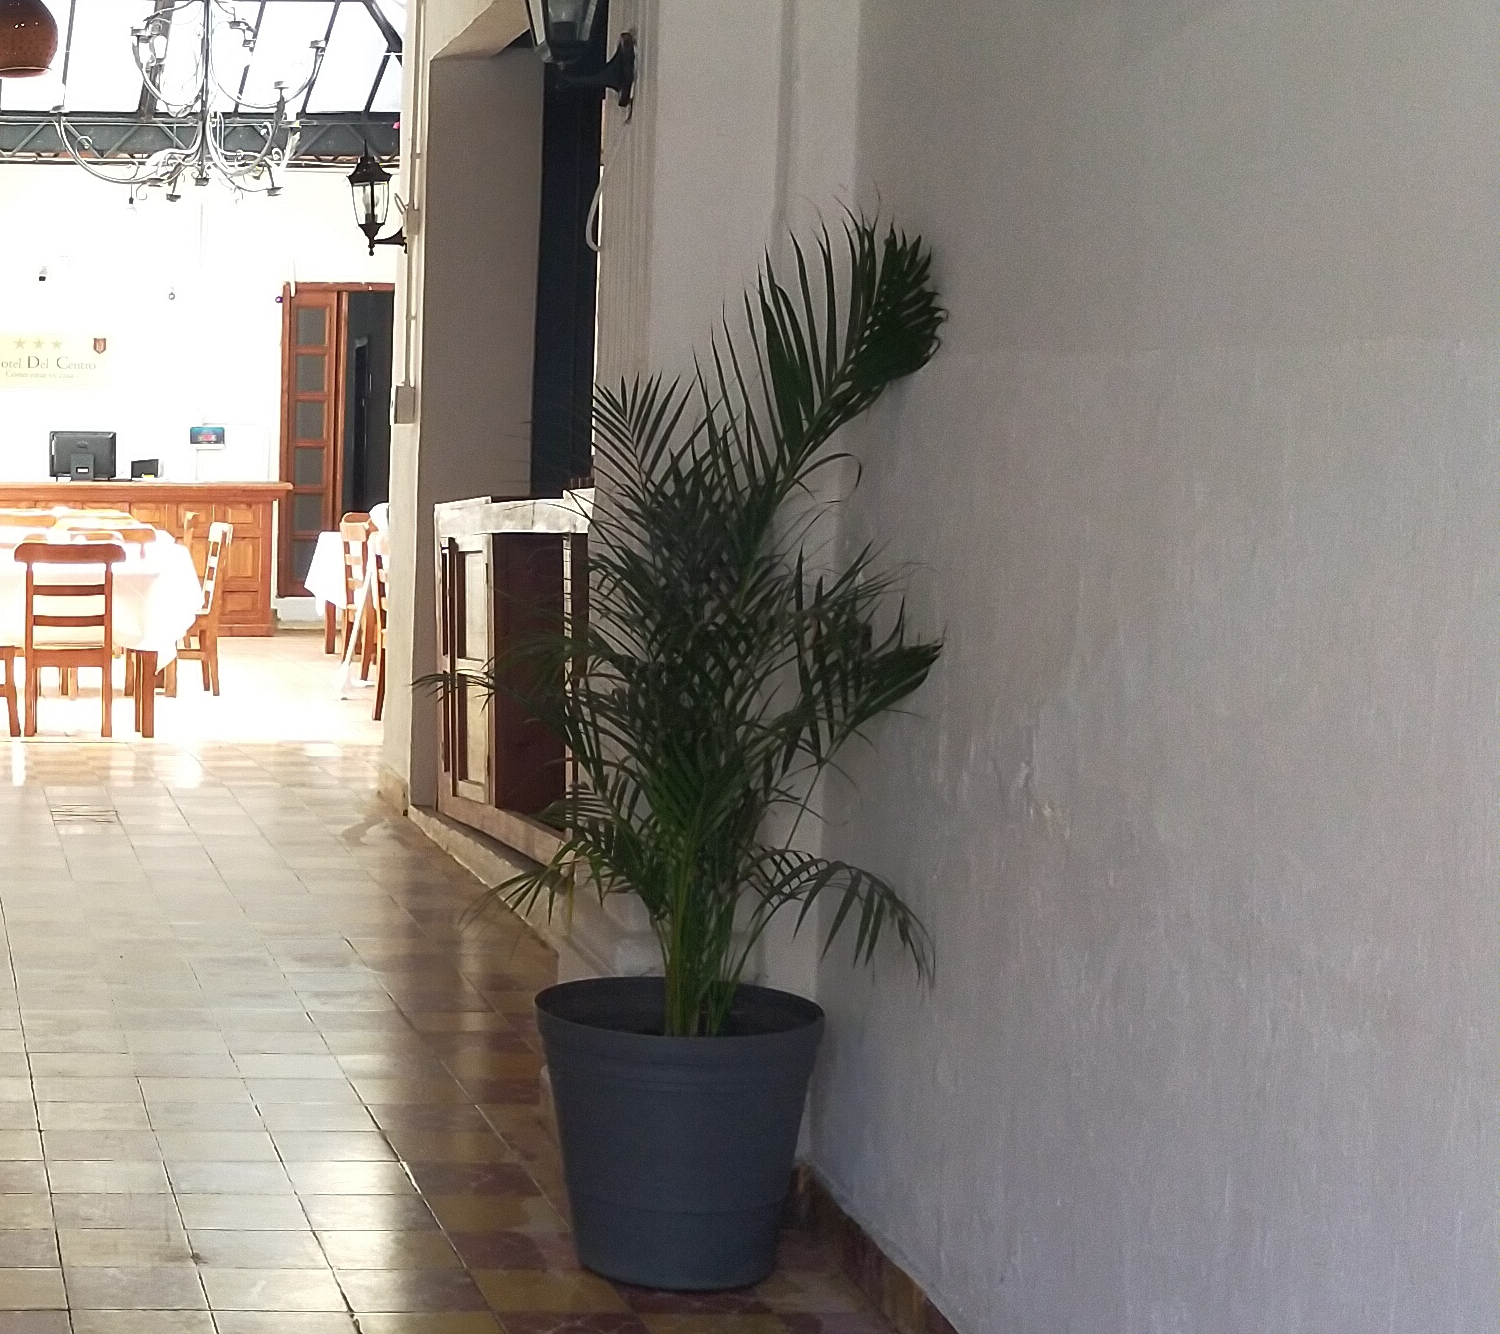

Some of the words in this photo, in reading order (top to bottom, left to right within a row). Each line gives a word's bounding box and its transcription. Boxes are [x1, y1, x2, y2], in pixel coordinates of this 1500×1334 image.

[27, 355, 49, 369] Del
[56, 356, 97, 370] Centro
[5, 369, 28, 378] Como
